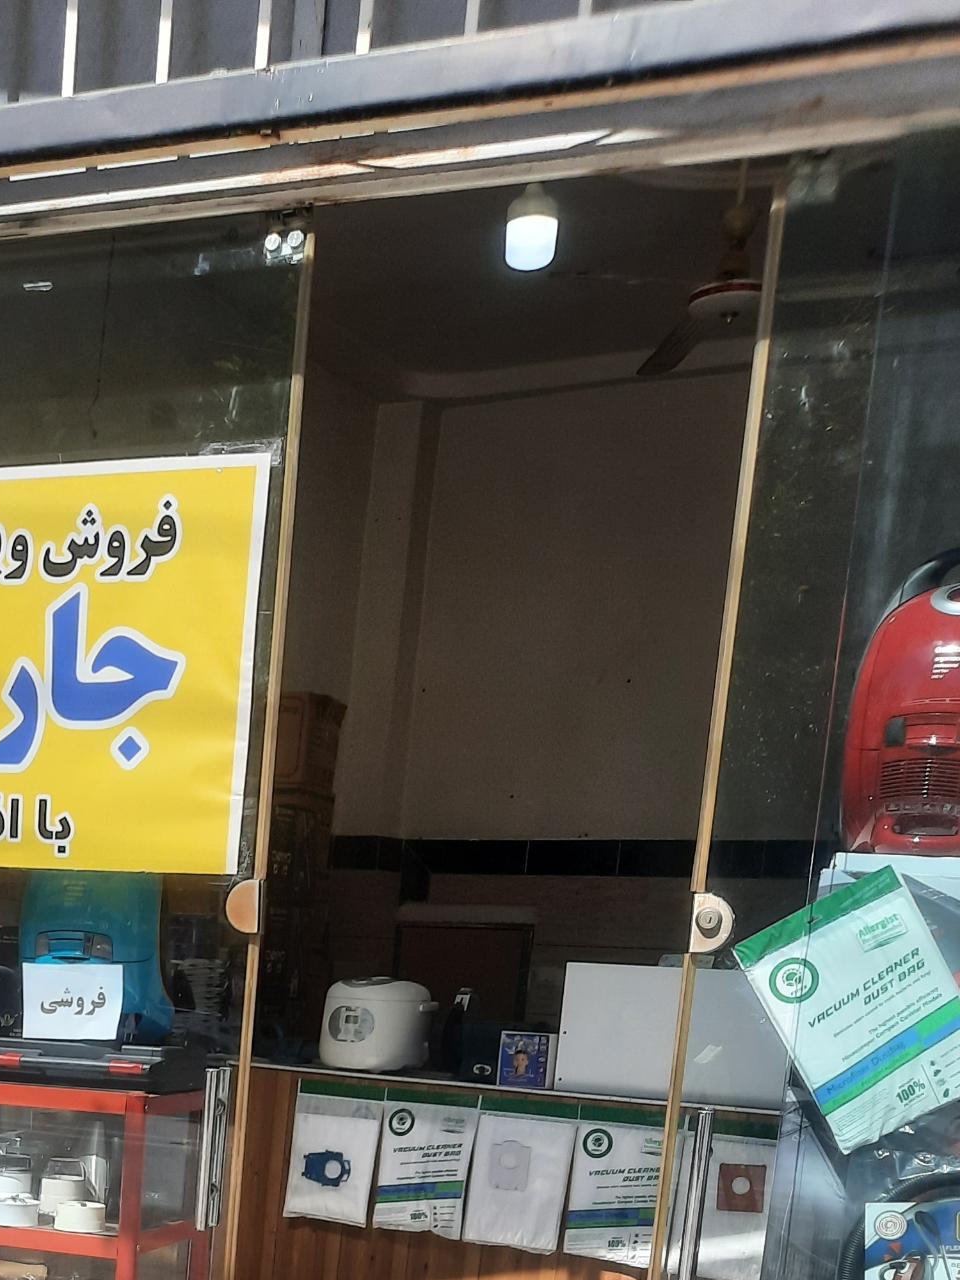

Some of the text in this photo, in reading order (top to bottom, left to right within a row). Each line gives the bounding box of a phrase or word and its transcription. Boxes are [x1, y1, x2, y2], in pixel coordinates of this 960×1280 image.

[42, 497, 178, 578] فروش
[37, 798, 72, 854] با
[858, 913, 900, 938] Allergist
[808, 988, 861, 1028] VACUUM
[862, 947, 920, 992] CLEANER
[863, 978, 895, 1006] DUST
[898, 959, 926, 982] BAG
[40, 986, 107, 1016] فروشی
[896, 1079, 926, 1104] 100%
[392, 1143, 463, 1153] VACUUM CLEANER
[589, 1168, 626, 1176] VACUUM
